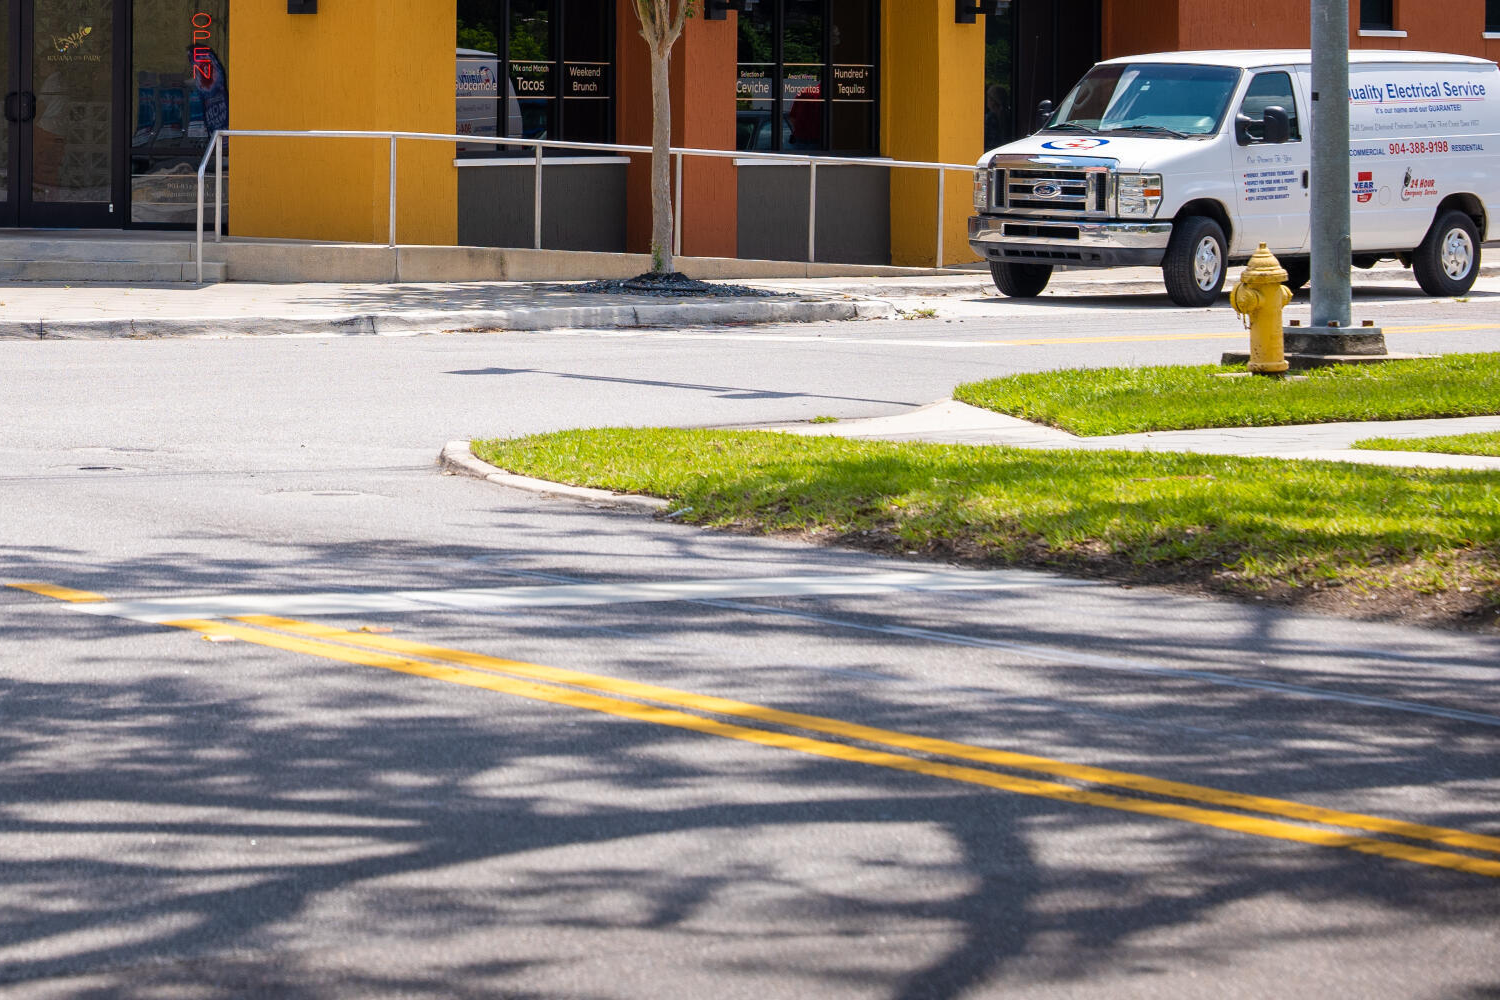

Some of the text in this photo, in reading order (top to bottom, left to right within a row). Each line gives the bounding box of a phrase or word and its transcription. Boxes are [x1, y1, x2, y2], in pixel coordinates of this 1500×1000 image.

[192, 12, 212, 80] OPEN
[513, 64, 549, 72] Mix and Match
[569, 67, 601, 77] Weekend
[834, 69, 864, 79] Hundred
[516, 77, 545, 91] Tacos
[573, 82, 597, 91] Brunch
[736, 81, 770, 94] Ceviche
[784, 83, 820, 96] Margaritas
[837, 83, 866, 96] Tequilas
[1385, 82, 1441, 99] Electrical
[1442, 81, 1486, 97] Service
[1349, 140, 1484, 157] COMMERCIAL 904-388-9198 RESIDENTIAL
[1410, 179, 1435, 188] 24 HOUR
